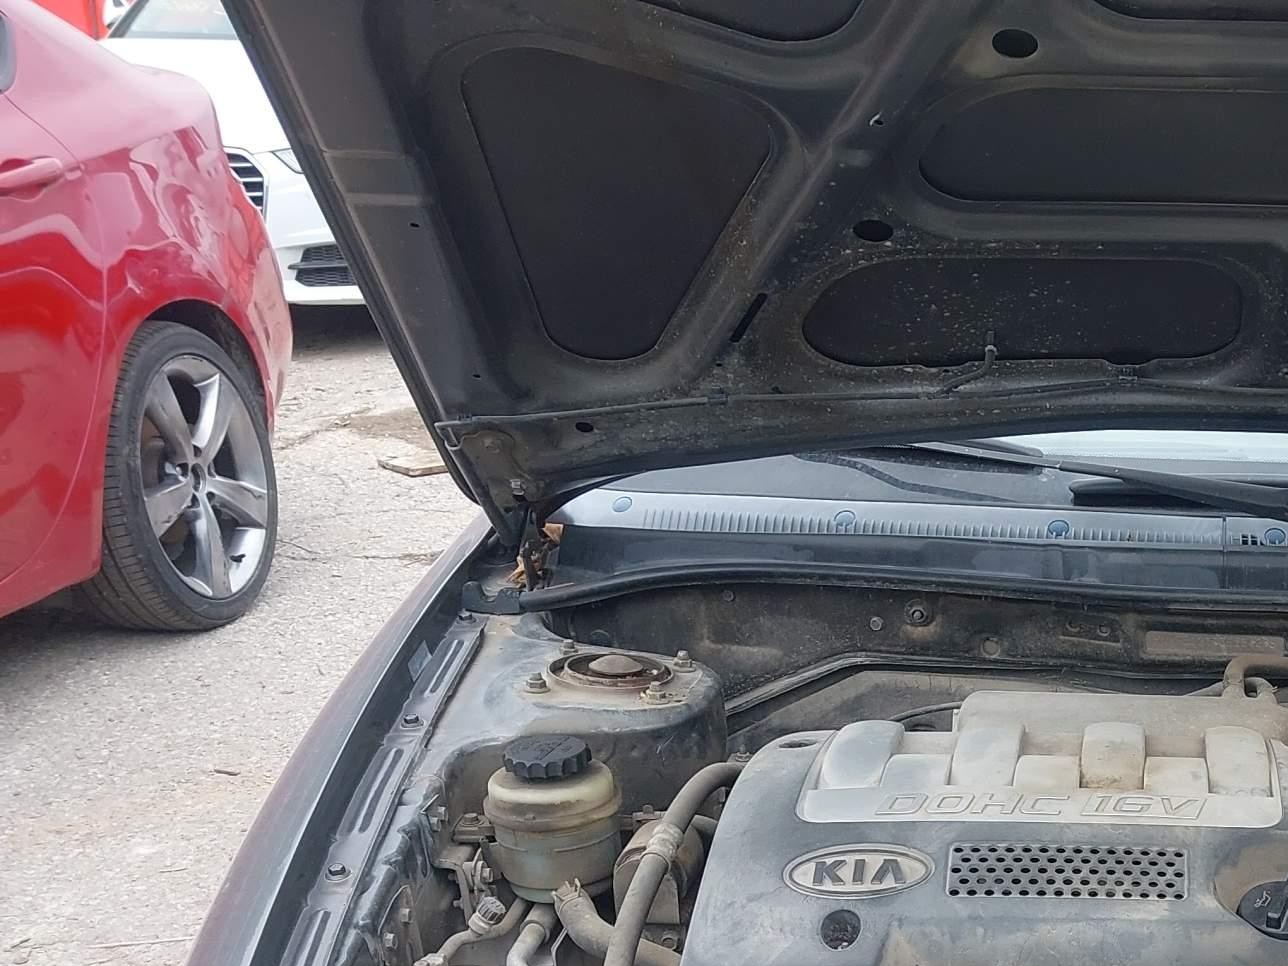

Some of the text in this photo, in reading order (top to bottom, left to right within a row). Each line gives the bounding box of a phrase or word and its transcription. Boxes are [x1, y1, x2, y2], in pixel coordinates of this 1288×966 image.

[875, 792, 1207, 819] DOHC 16V
[812, 858, 907, 887] KIA
